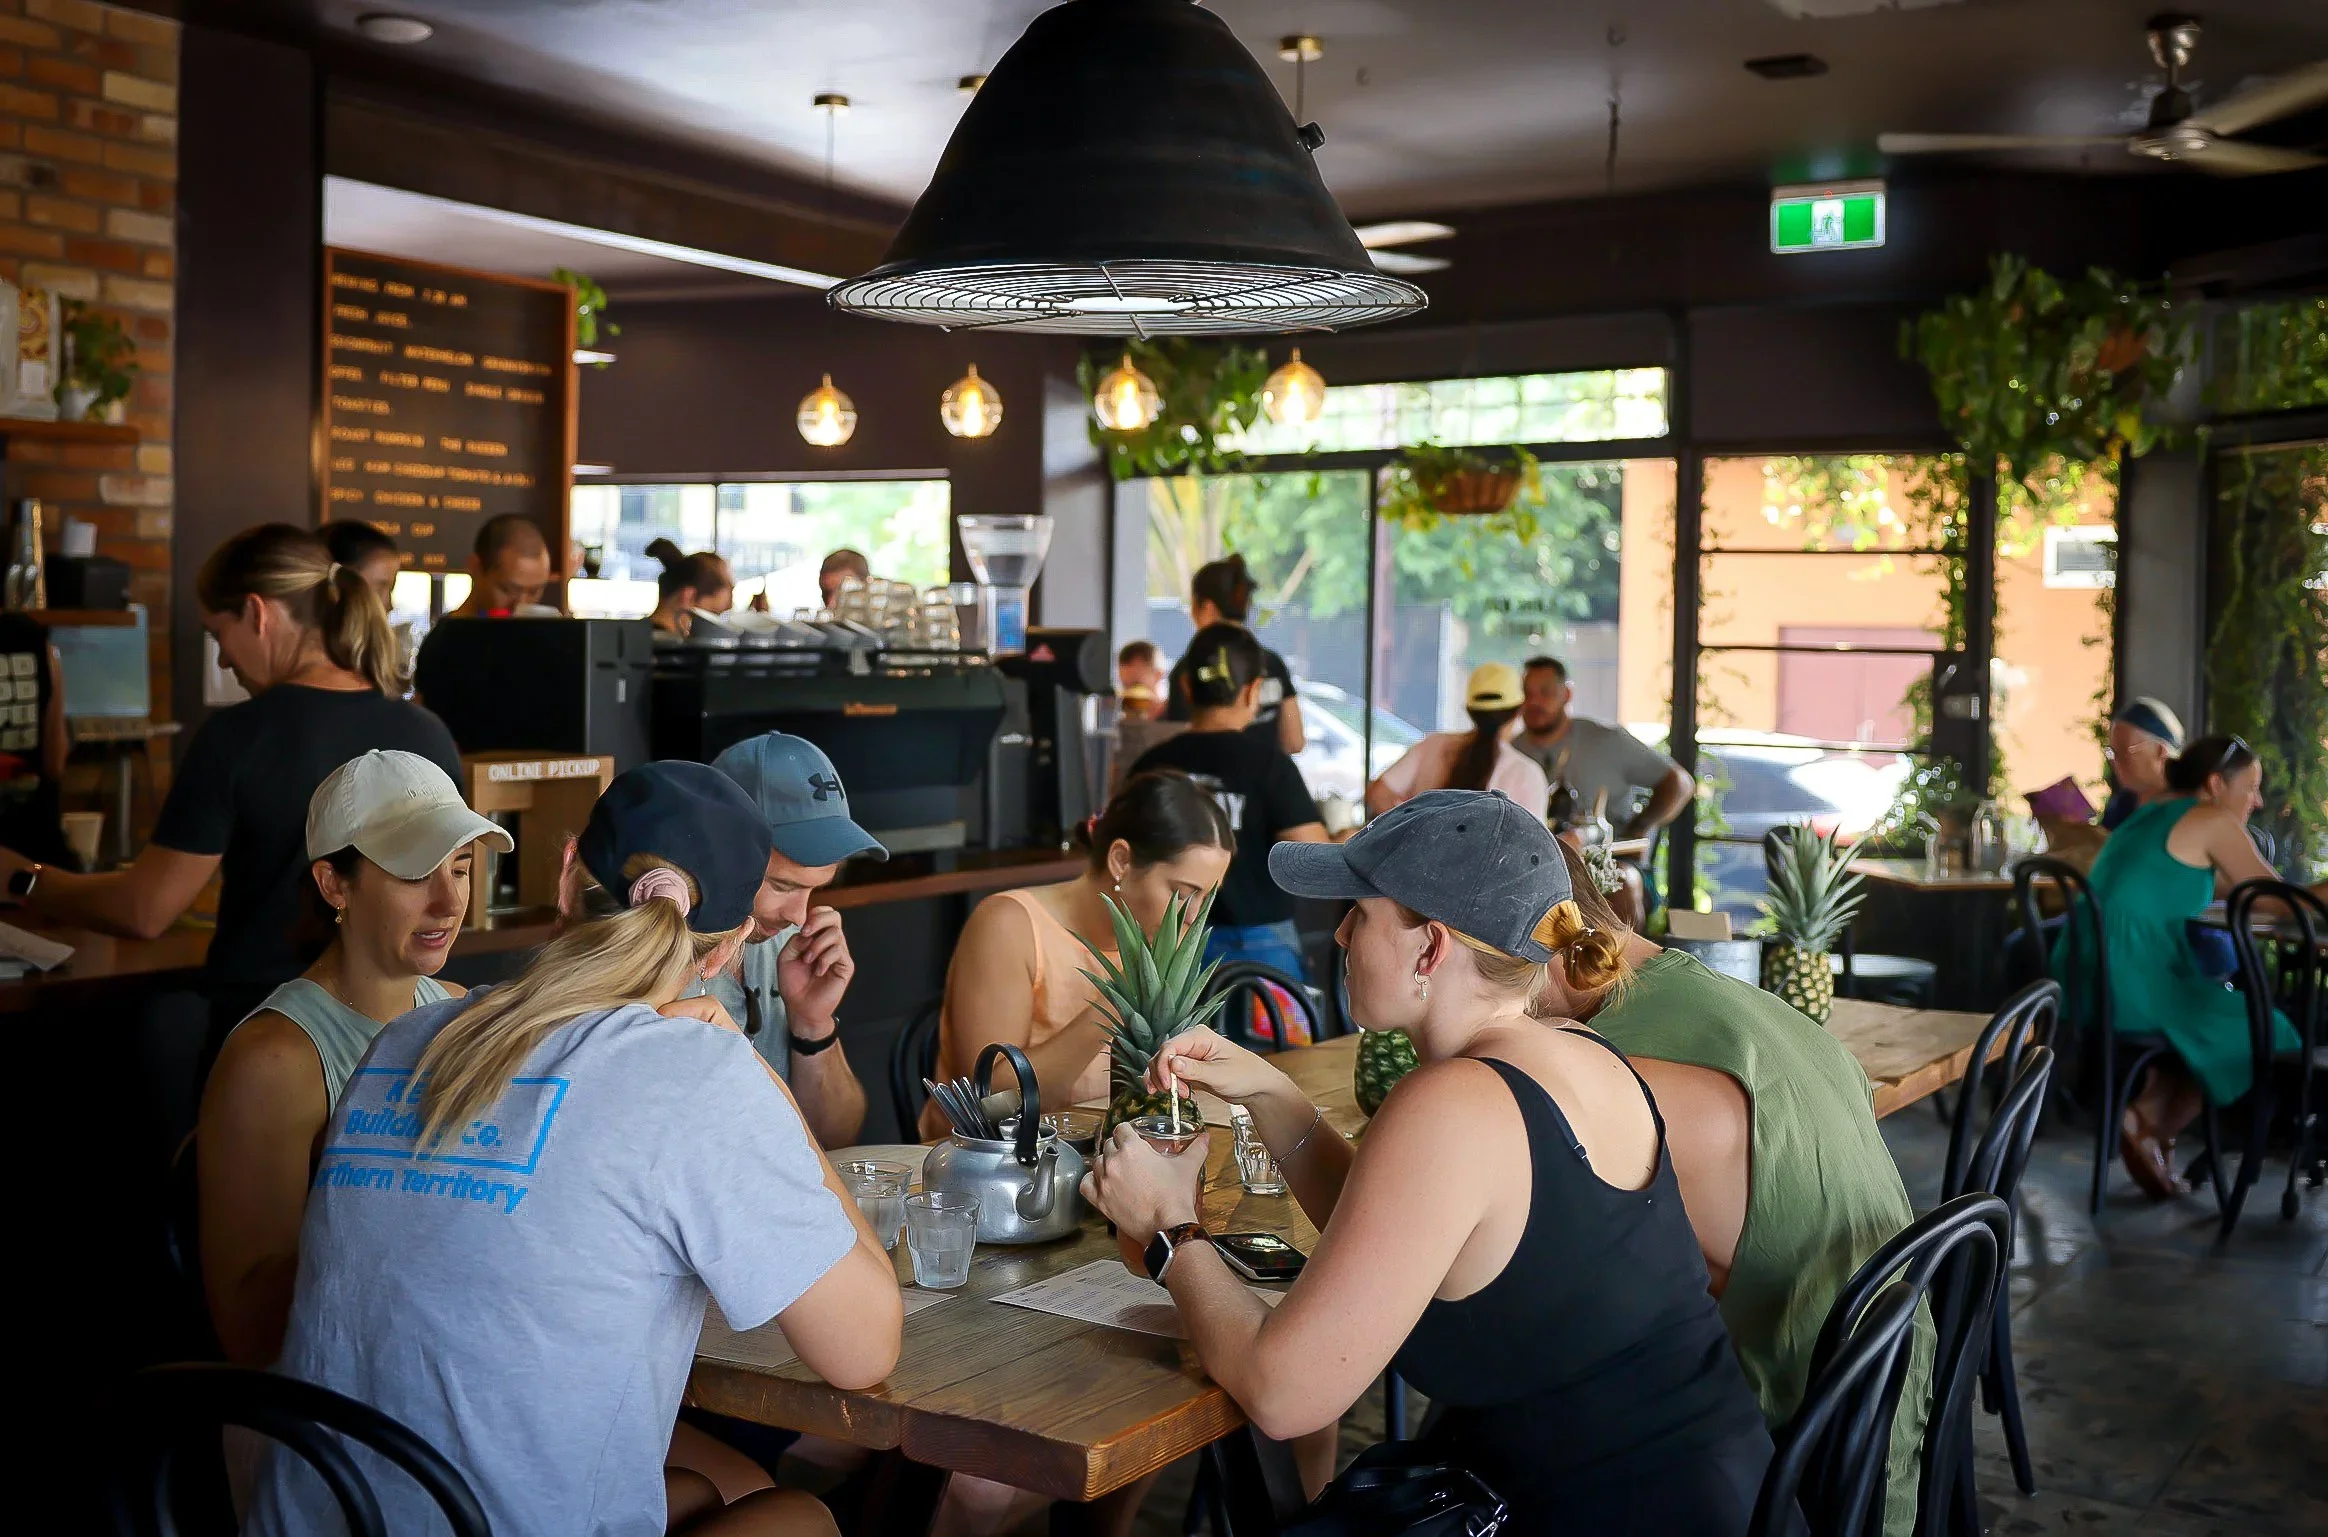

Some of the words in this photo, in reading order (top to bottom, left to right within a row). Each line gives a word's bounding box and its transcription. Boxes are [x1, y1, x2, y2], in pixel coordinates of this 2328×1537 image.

[488, 761, 542, 782] ONLINE
[548, 759, 600, 778] PICKUP
[402, 1169, 528, 1216] Territory
